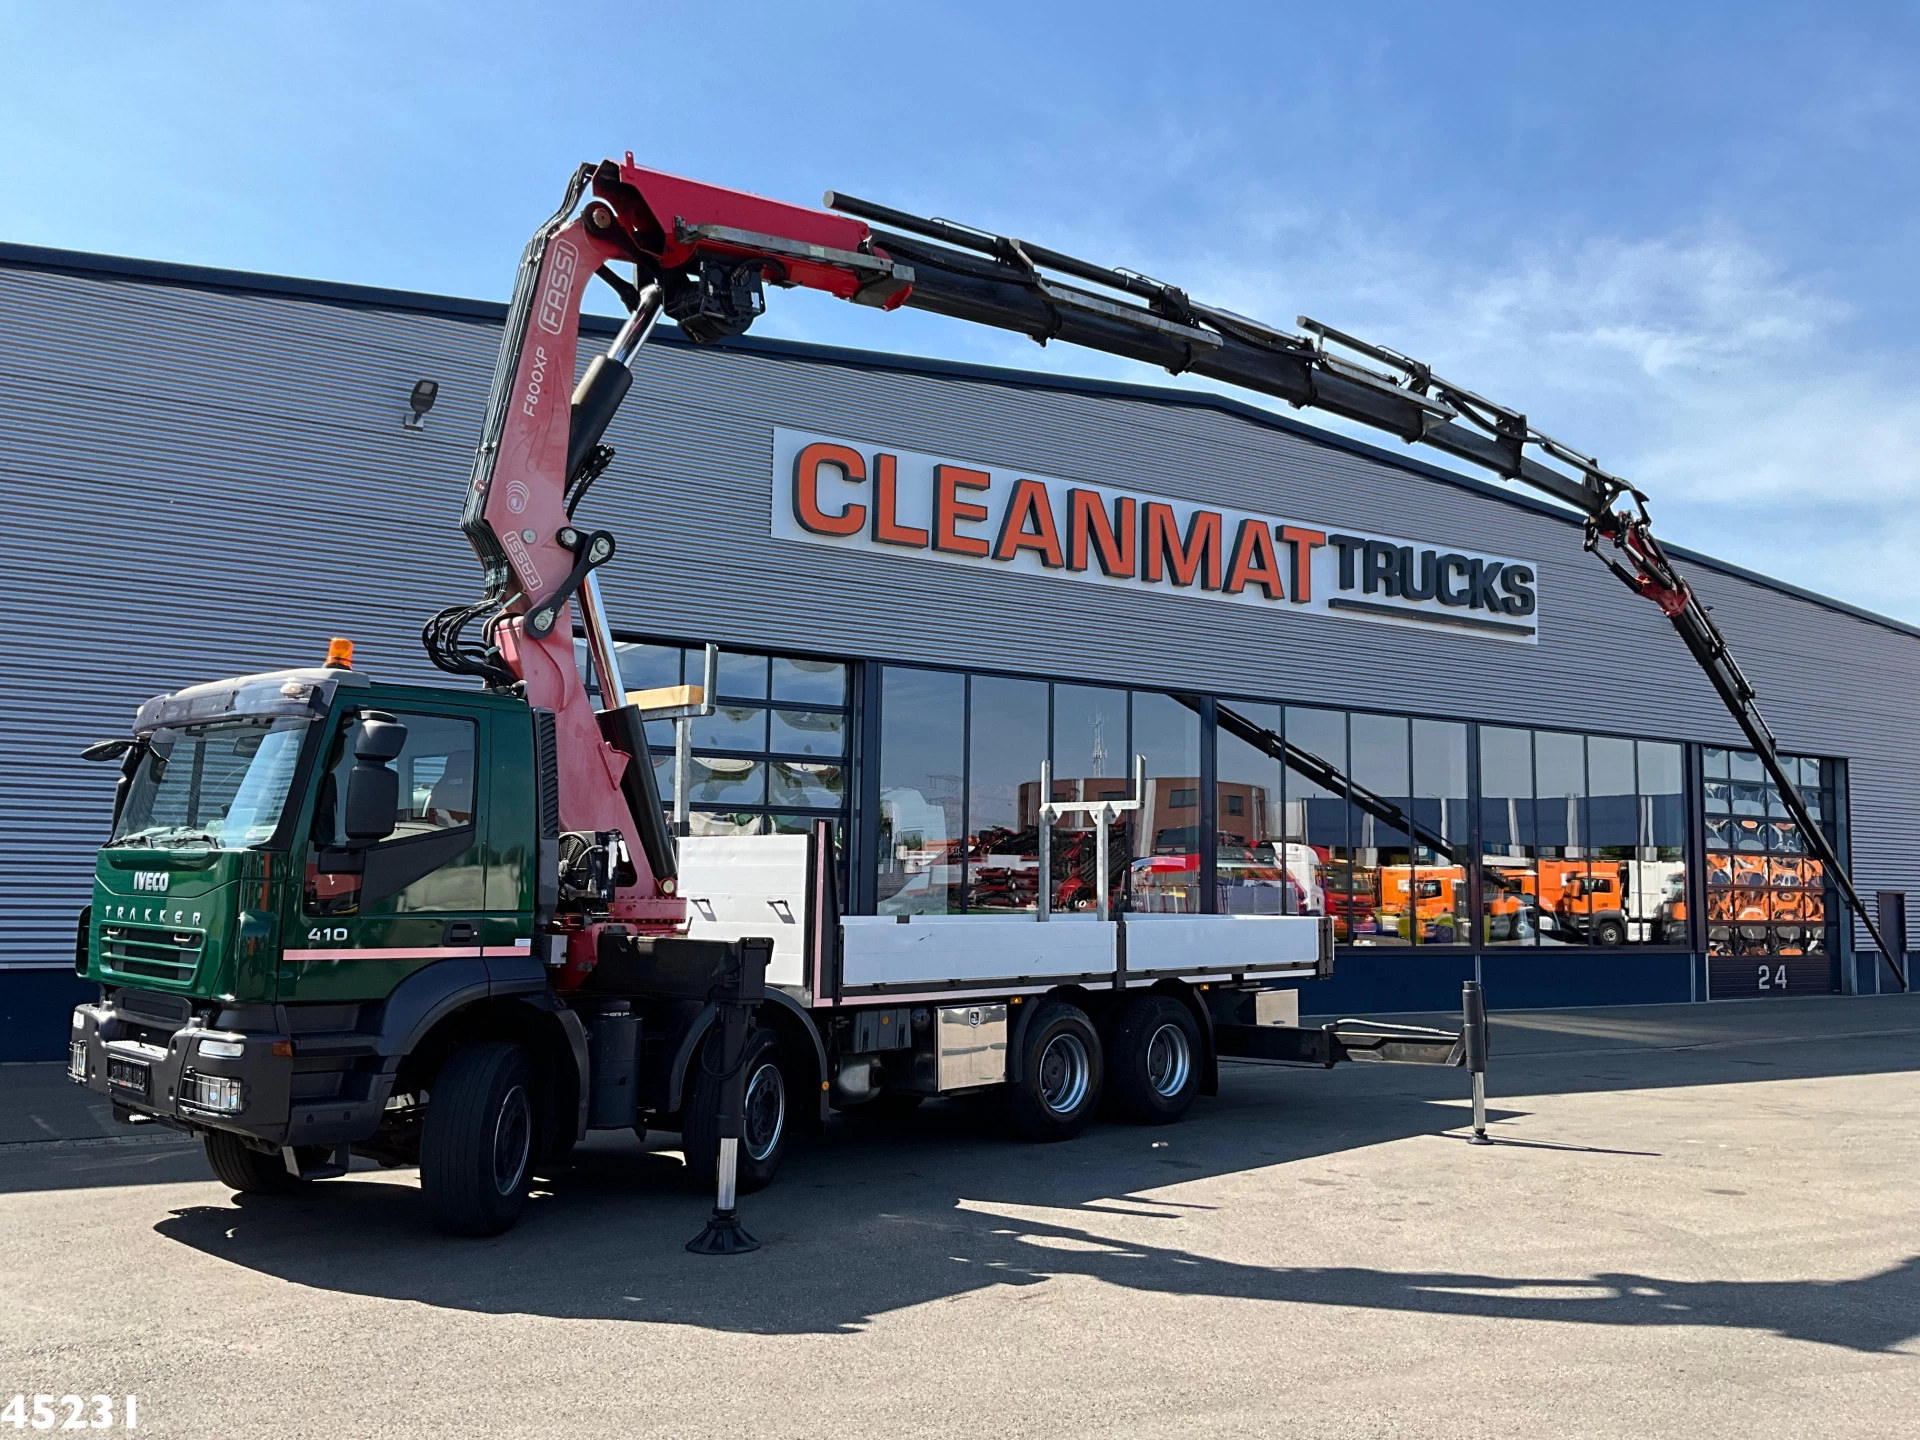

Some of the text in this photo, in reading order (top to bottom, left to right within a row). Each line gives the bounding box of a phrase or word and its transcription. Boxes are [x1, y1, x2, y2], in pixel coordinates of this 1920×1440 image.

[542, 245, 575, 328] FASSI
[523, 346, 548, 417] F800XP
[791, 442, 1536, 616] CLEANMAT TRUCKS
[507, 536, 539, 586] FASSI
[133, 871, 170, 892] IVECO
[105, 905, 201, 926] TRAKKER
[307, 927, 348, 941] 410
[1758, 965, 1788, 990] 24
